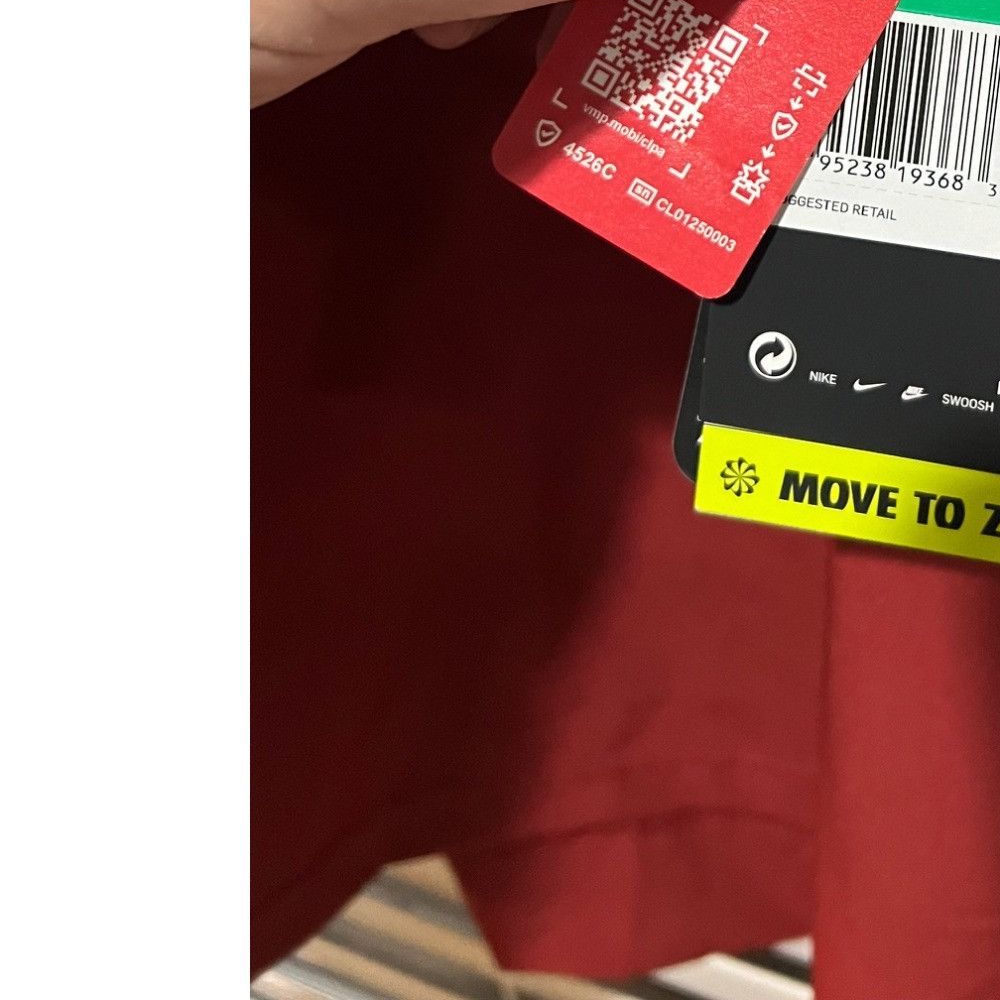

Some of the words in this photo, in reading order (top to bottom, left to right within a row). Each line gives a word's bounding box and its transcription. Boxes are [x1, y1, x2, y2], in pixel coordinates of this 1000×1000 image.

[583, 103, 666, 158] vmp.mobi/clpa
[563, 142, 617, 180] 4526C
[819, 155, 886, 179] 95238
[898, 166, 964, 191] 19368
[988, 183, 998, 197] 3
[656, 198, 737, 253] CL01250003
[783, 194, 849, 214] GGESTED
[852, 204, 897, 221] RETAIL
[809, 370, 838, 385] NIKE
[941, 393, 995, 412] SWOOSH
[779, 469, 899, 520] MOVE
[914, 490, 966, 531] TO
